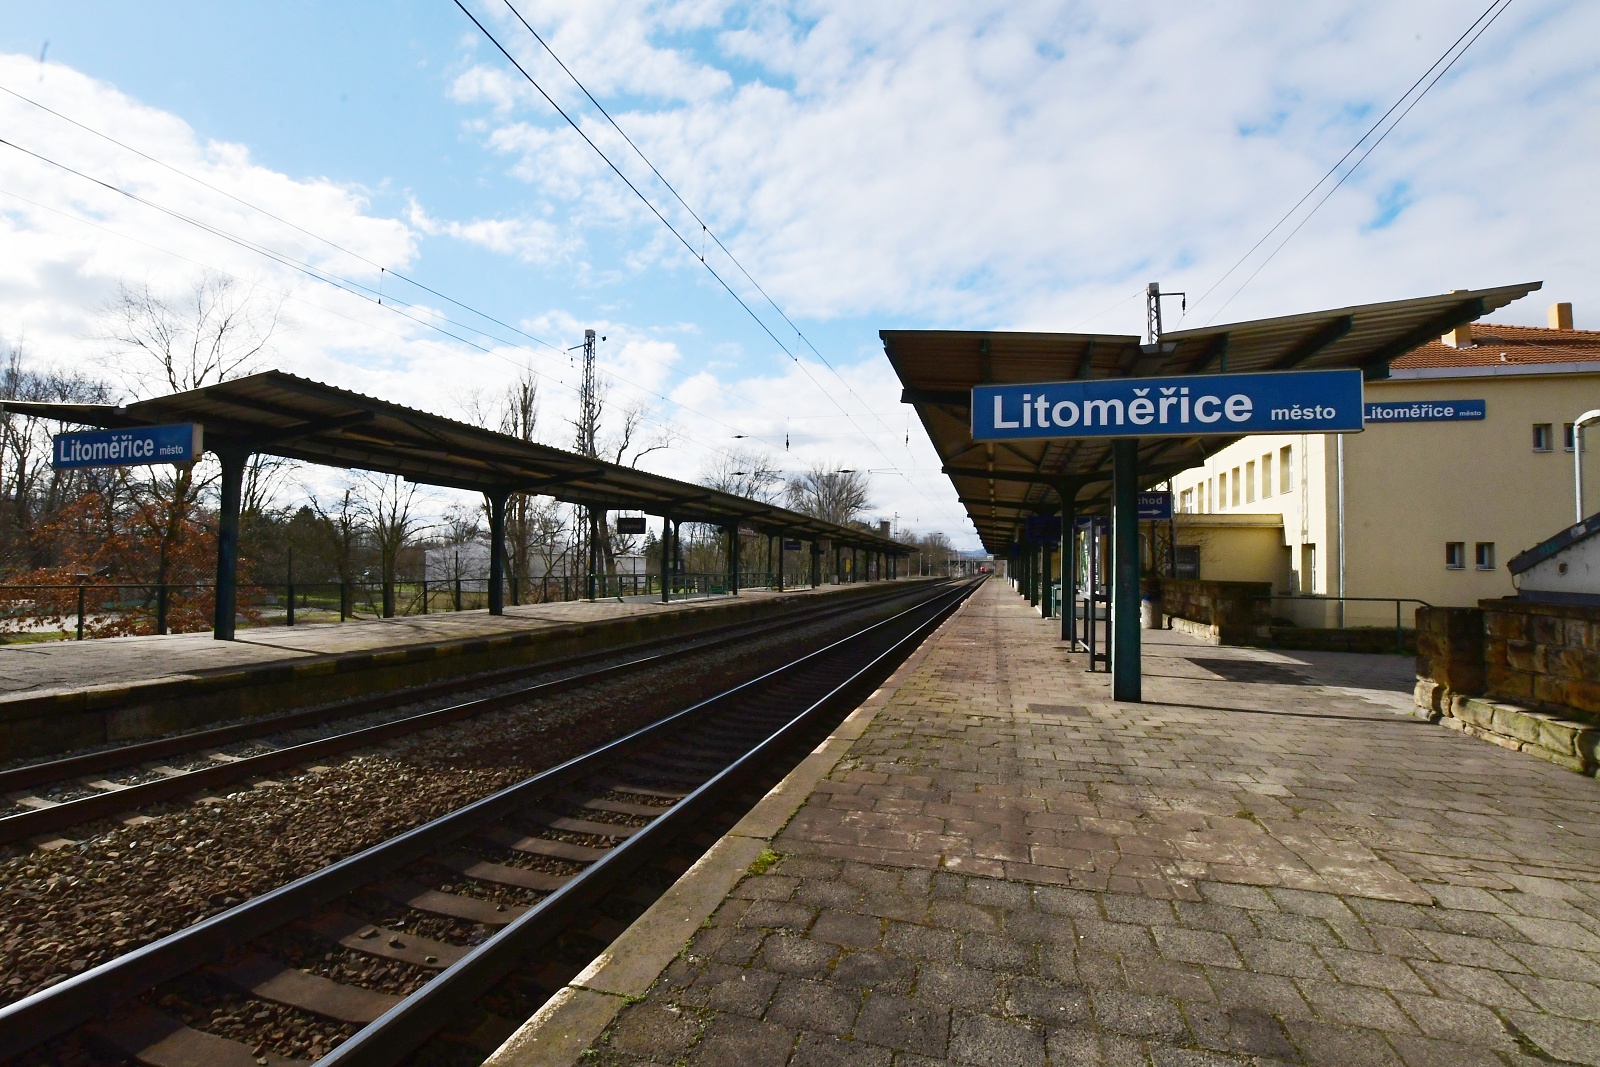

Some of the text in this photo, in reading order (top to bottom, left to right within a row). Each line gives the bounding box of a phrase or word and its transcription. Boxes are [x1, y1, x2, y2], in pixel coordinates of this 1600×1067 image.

[993, 386, 1336, 429] Litoměřice město
[60, 435, 184, 462] Litoměřice město
